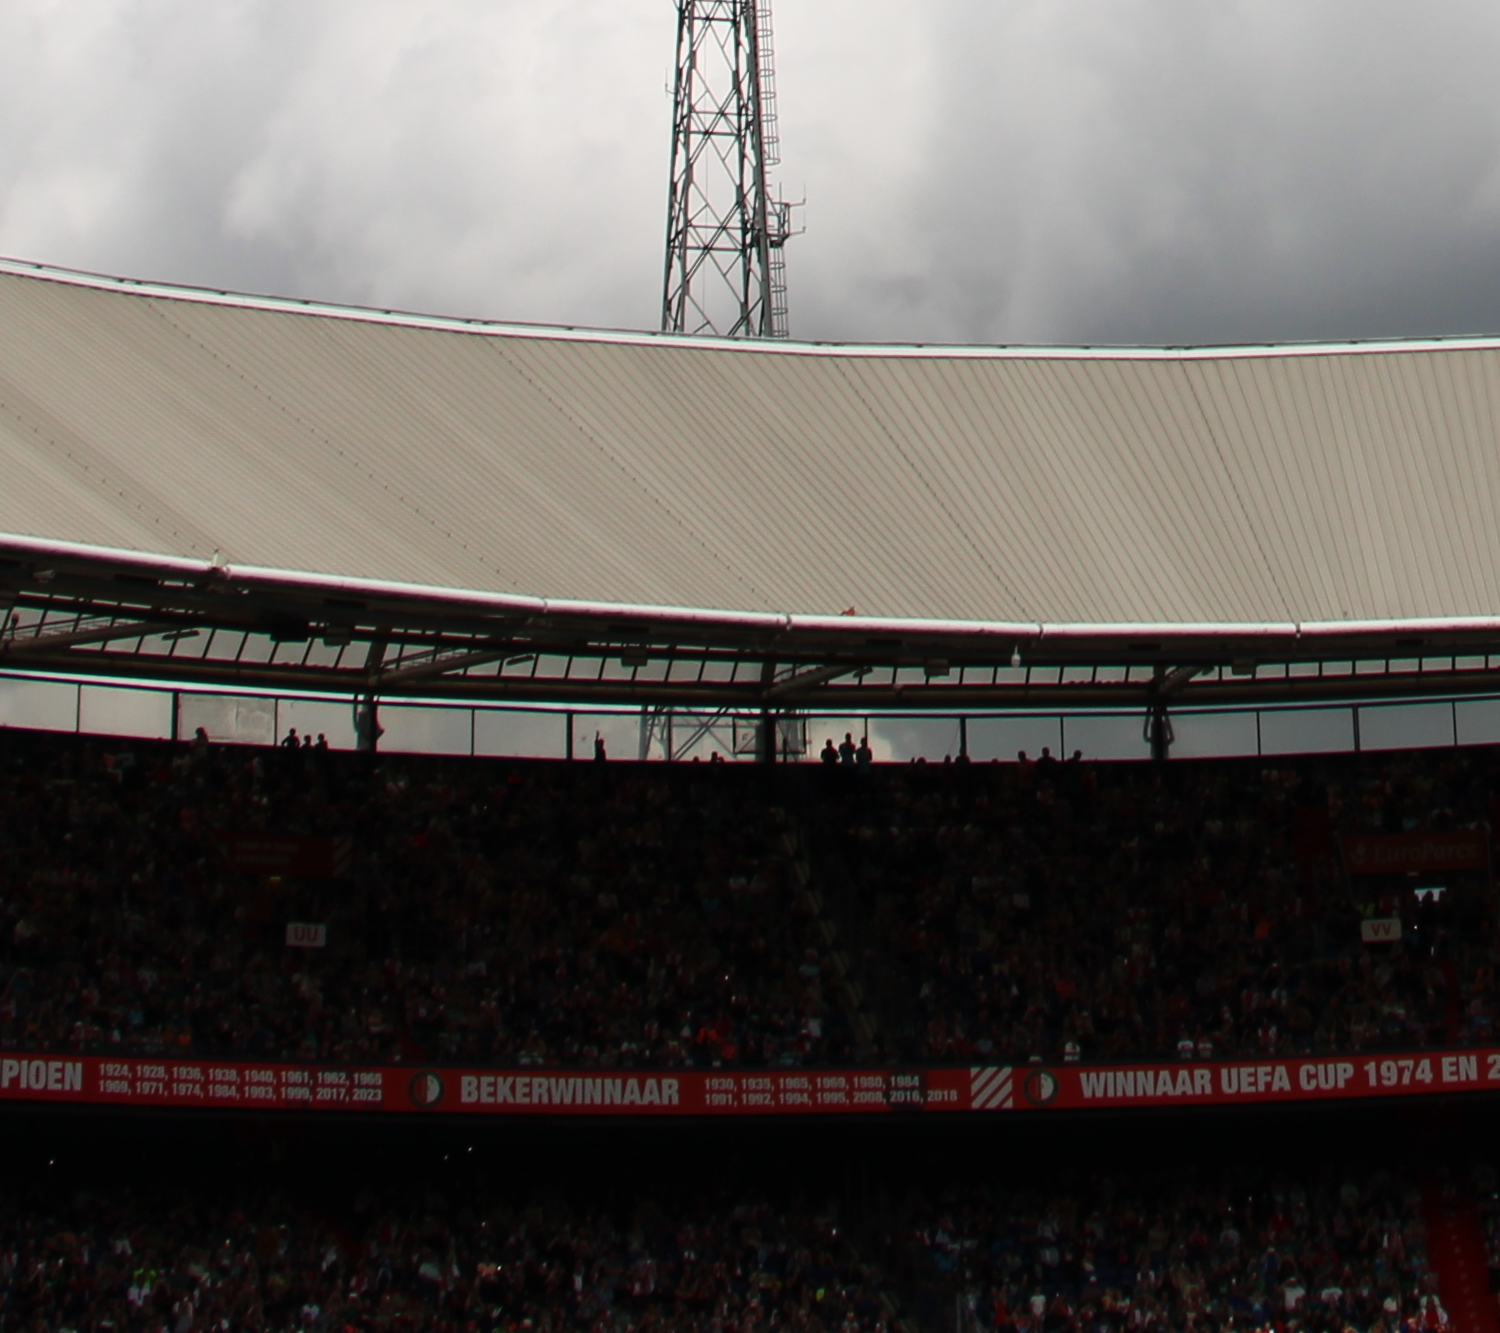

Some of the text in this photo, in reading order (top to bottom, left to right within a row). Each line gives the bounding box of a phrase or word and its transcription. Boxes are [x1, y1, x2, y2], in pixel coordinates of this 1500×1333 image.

[1373, 841, 1478, 864] EuroParcs
[1370, 922, 1391, 936] VV
[99, 1063, 132, 1079] 1924,
[136, 1065, 169, 1081] 1928,
[244, 1069, 276, 1084] 1940,
[280, 1070, 313, 1085] 1961,
[316, 1071, 349, 1086] 1962,
[705, 1078, 737, 1092] 1930,
[1080, 1069, 1212, 1098] WINNAAR
[1220, 1064, 1291, 1094] UEFA
[1299, 1062, 1354, 1090] CUP
[1364, 1058, 1433, 1087] 1974
[1441, 1055, 1478, 1082] EN
[136, 1081, 168, 1097] 1971,
[172, 1083, 204, 1099] 1974,
[244, 1085, 276, 1101] 1993,
[280, 1086, 313, 1101] 1999,
[316, 1087, 349, 1103] 2017,
[352, 1088, 382, 1101] 2023
[460, 1075, 679, 1105] BEKERWINNAAR
[705, 1093, 737, 1107] 1991,
[741, 1093, 775, 1107] 1992,
[779, 1092, 812, 1106] 1994,
[889, 1090, 923, 1104] 2016,
[927, 1089, 957, 1101] 2018
